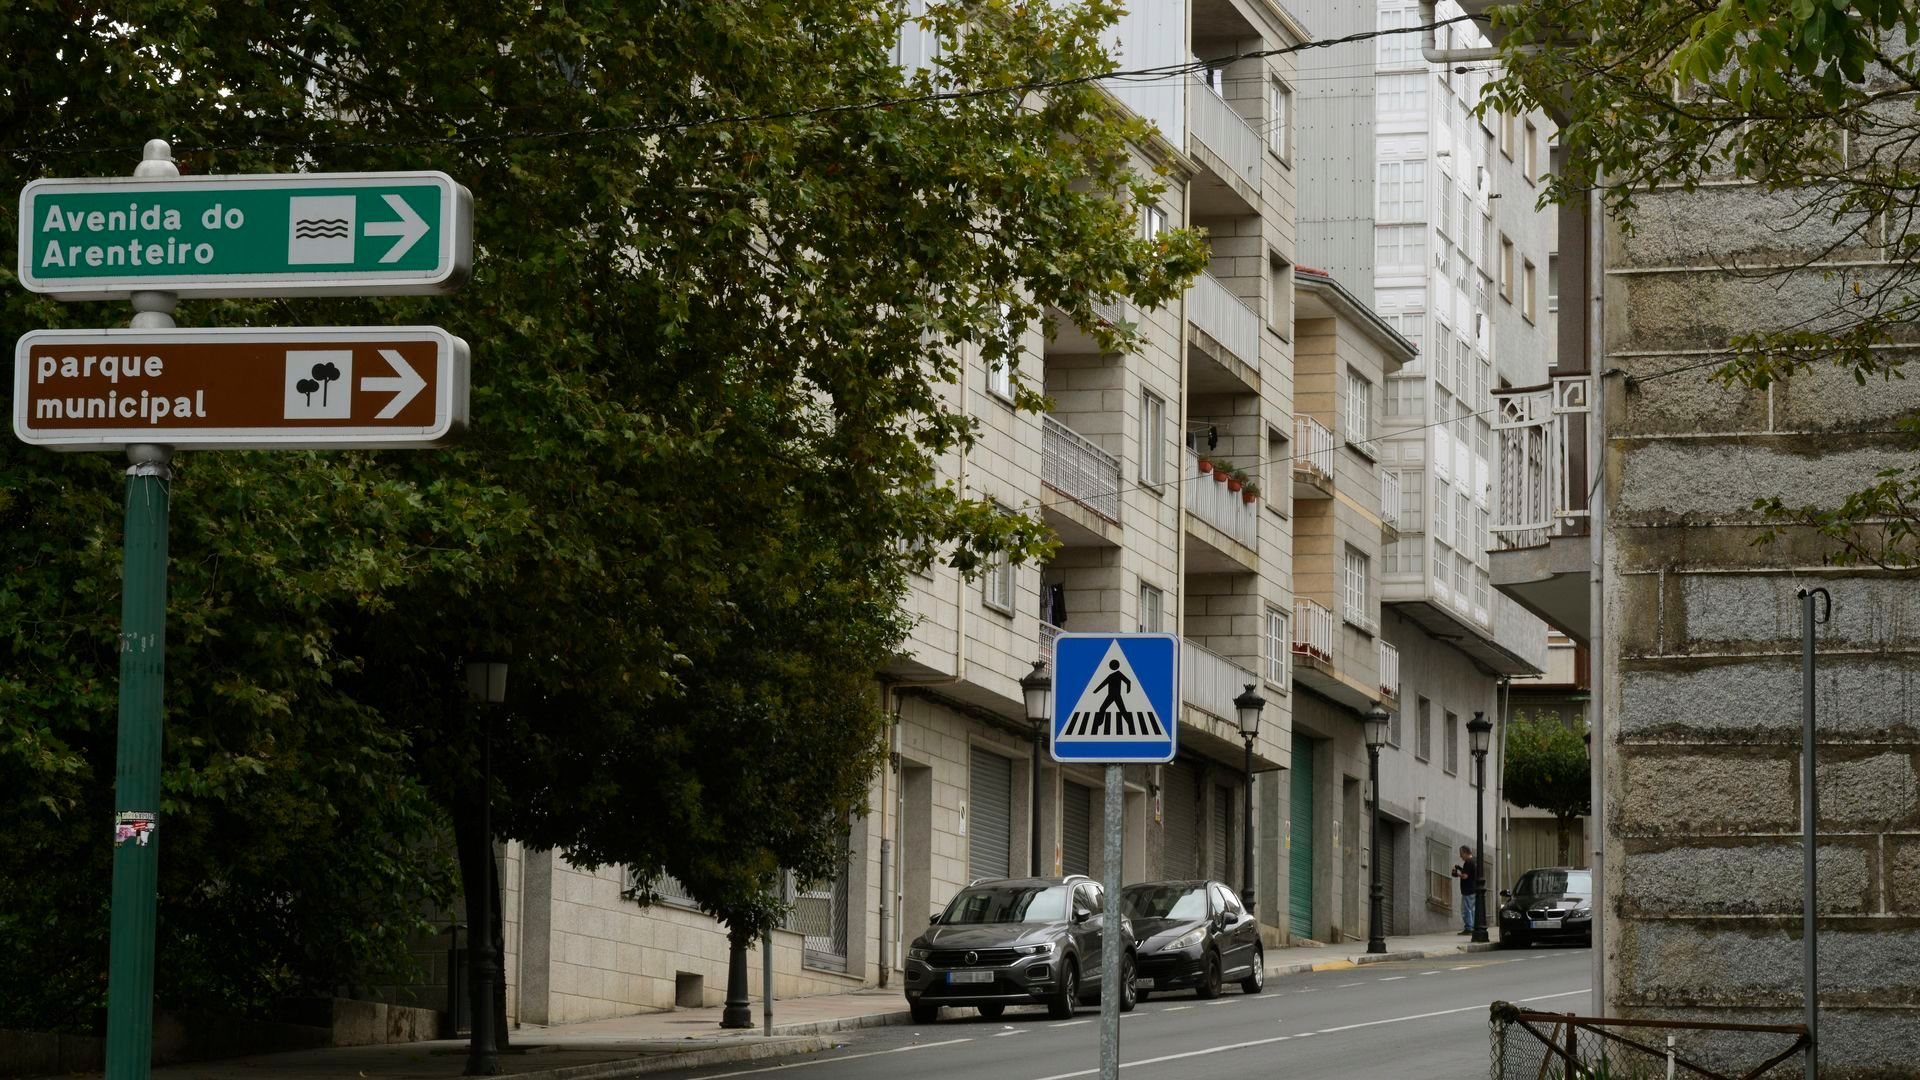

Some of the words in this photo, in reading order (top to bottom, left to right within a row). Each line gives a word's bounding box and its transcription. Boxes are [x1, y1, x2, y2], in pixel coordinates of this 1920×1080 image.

[42, 202, 182, 232] Avenida
[201, 203, 244, 230] do
[42, 237, 214, 267] Arenteiro
[37, 355, 163, 384] parque
[36, 390, 206, 423] municipal
